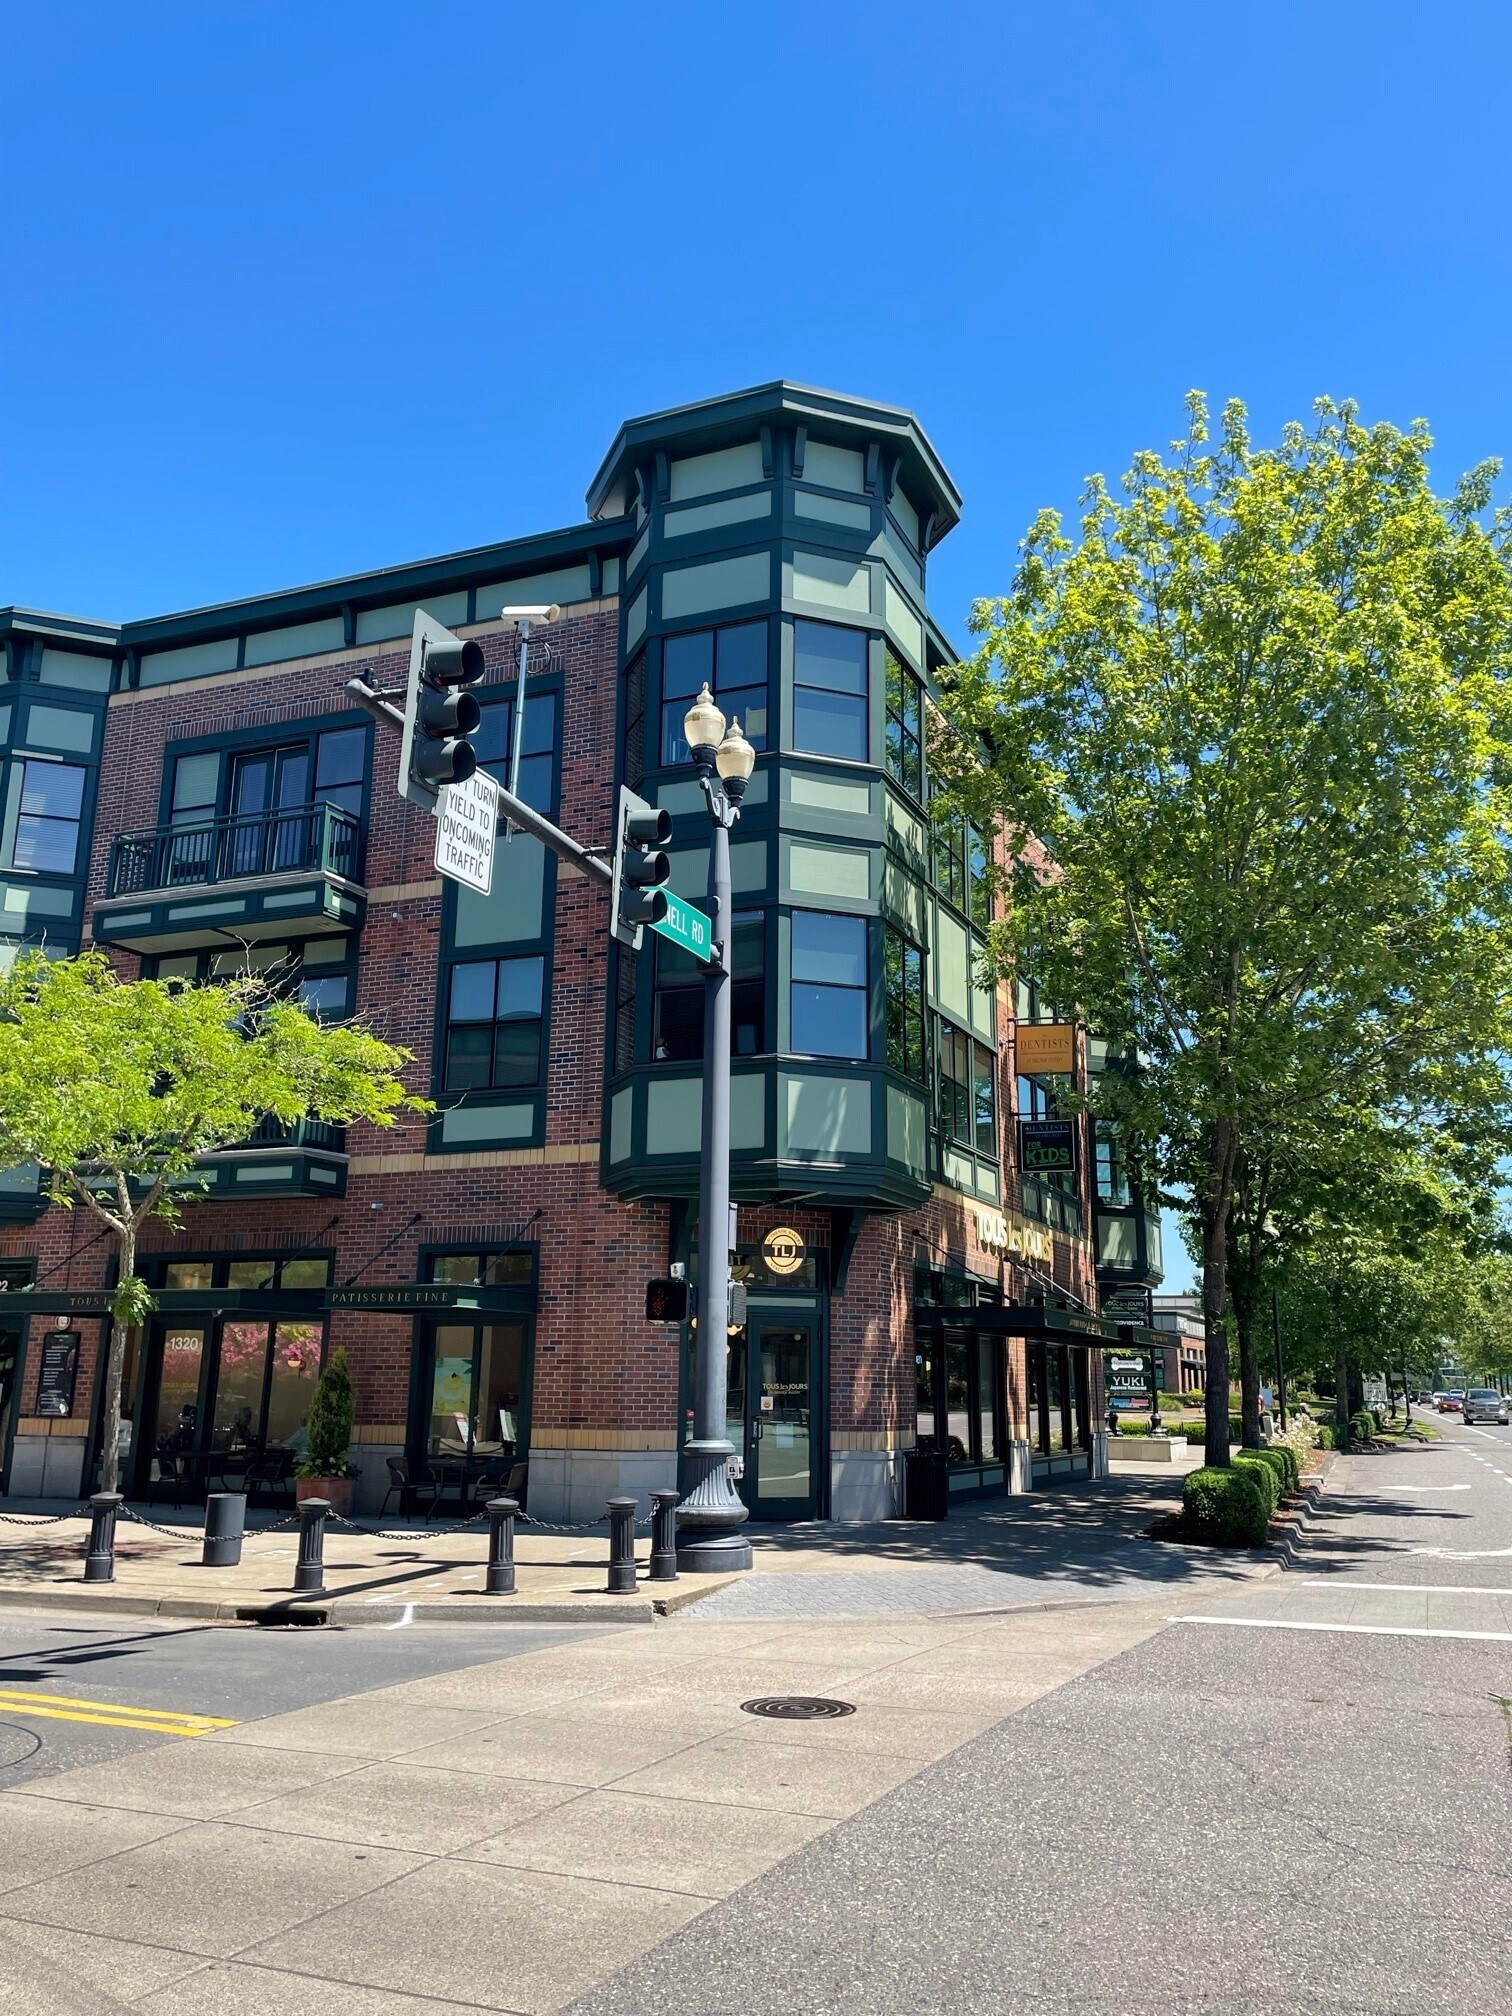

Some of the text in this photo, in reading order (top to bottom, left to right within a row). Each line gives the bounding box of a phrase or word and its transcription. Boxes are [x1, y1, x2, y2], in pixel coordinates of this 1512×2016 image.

[473, 779, 495, 808] TURN
[449, 790, 490, 830] YIELD TO
[442, 814, 491, 857] ONCOMING
[445, 842, 484, 879] TRAFFIC
[692, 919, 704, 945] RD
[1020, 1038, 1069, 1050] DENTISTS
[1027, 1141, 1041, 1149] FOR
[1025, 1147, 1070, 1164] KIDS
[973, 1209, 1053, 1262] TOUS les JOURS
[771, 1244, 796, 1258] TLJ
[69, 1296, 99, 1306] TOUS
[332, 1292, 449, 1303] PATISSERIE FINE
[170, 1337, 199, 1350] 1320
[788, 1383, 809, 1391] JOURS
[1112, 1376, 1144, 1386] YUKI
